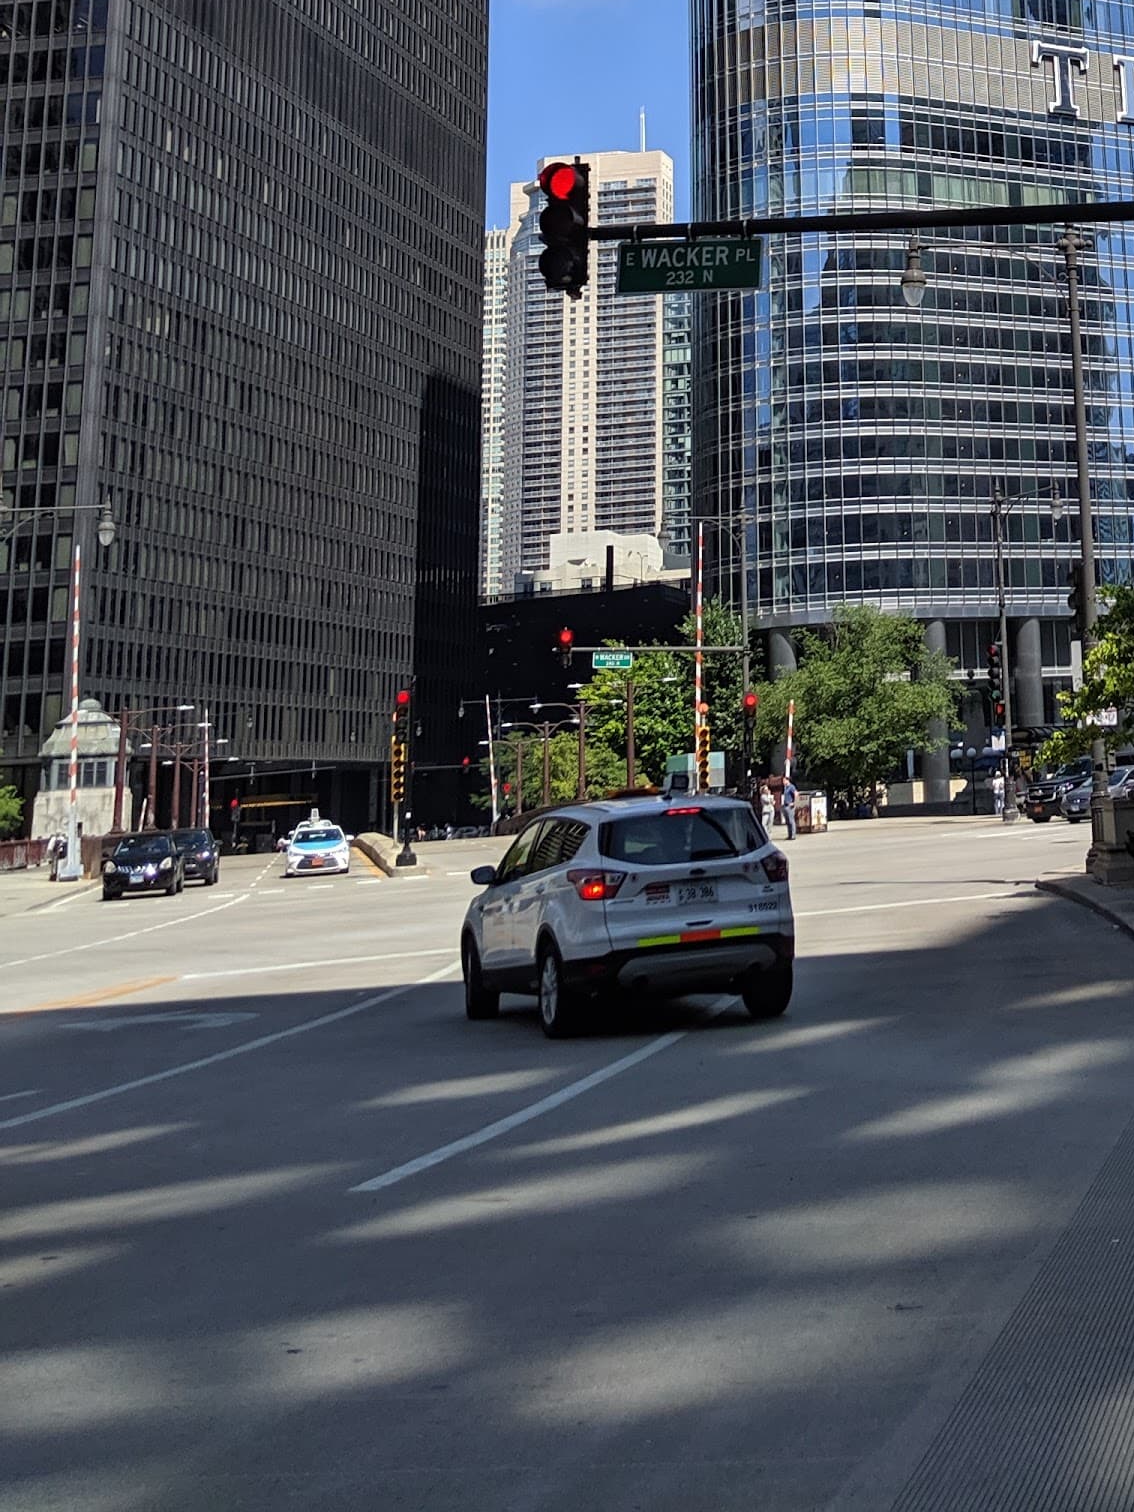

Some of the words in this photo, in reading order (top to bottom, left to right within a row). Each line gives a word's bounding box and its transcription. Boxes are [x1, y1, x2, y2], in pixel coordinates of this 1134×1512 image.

[626, 252, 635, 267] E
[641, 246, 728, 268] WACKER
[736, 248, 755, 262] PL
[666, 271, 694, 285] 232
[703, 270, 713, 283] N
